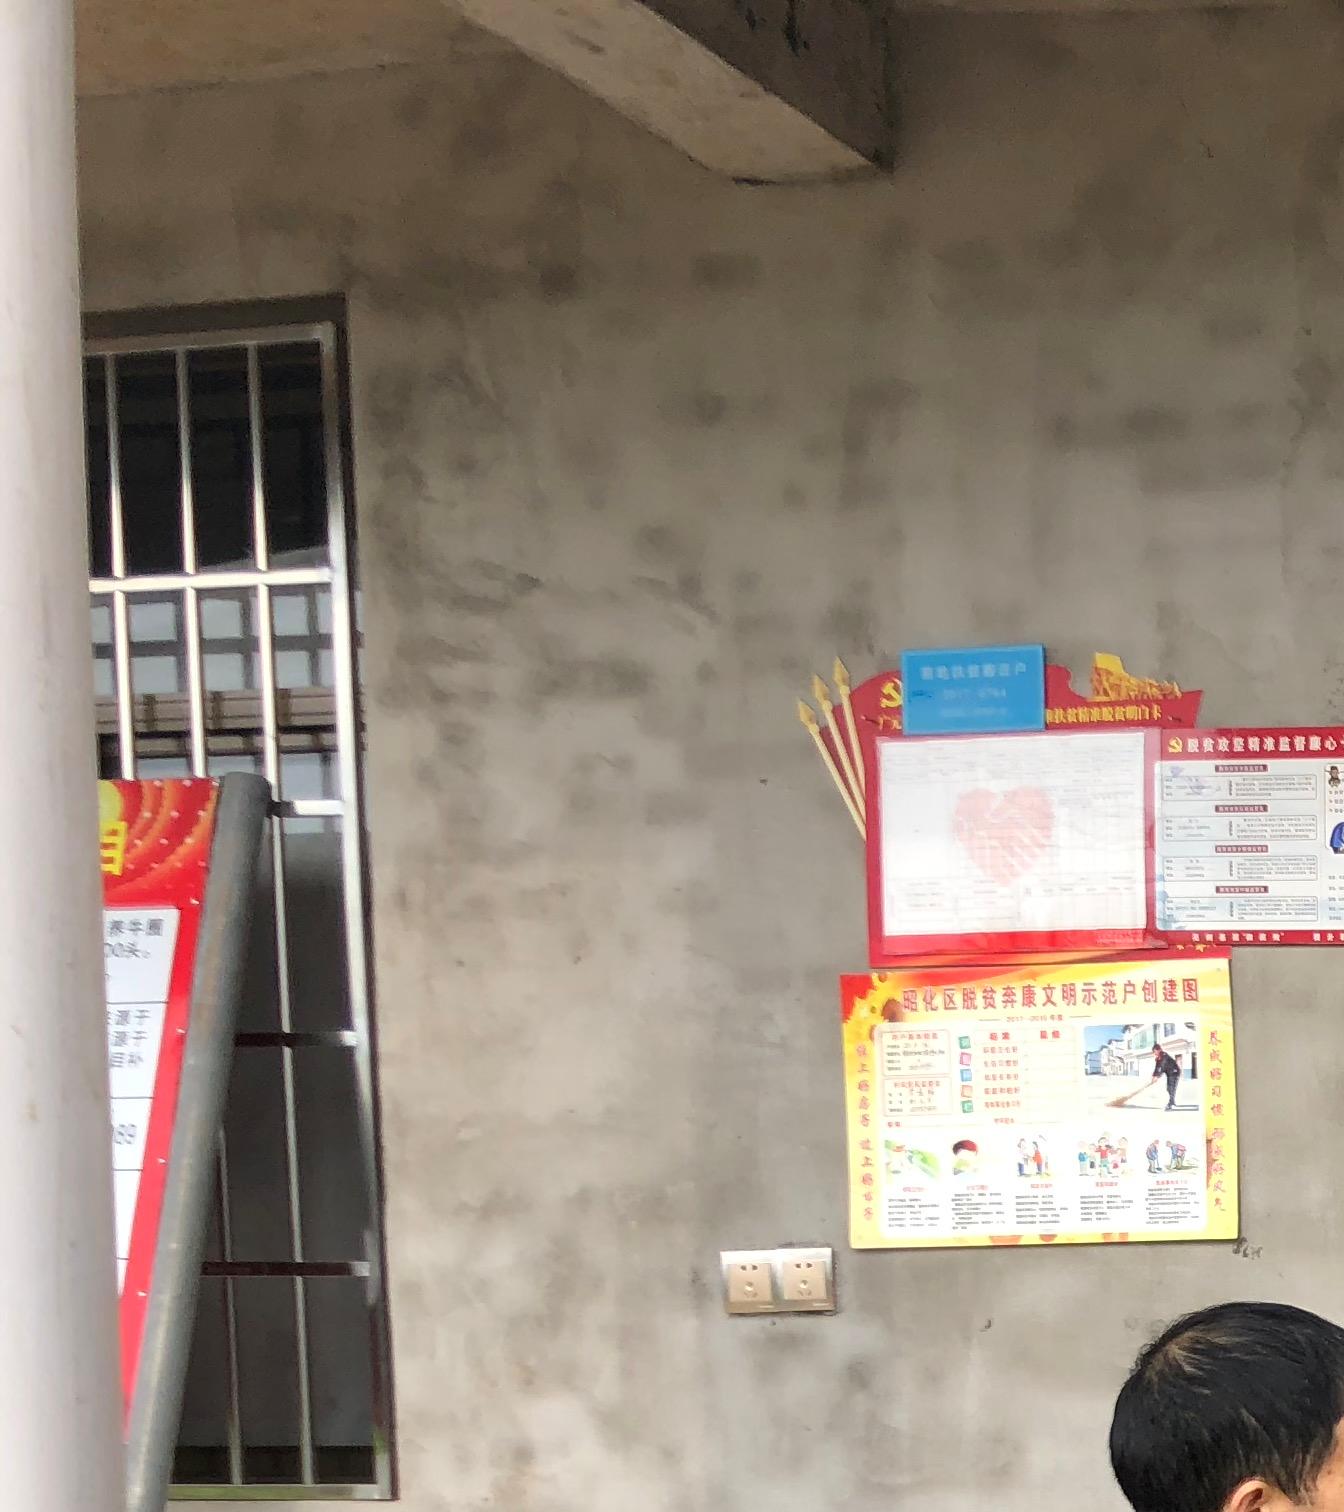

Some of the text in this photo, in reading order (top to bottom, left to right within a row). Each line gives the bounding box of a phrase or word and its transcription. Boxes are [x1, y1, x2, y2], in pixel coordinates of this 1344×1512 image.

[902, 978, 1200, 1012] 昭化区脱贫奔康文明示范户创建图
